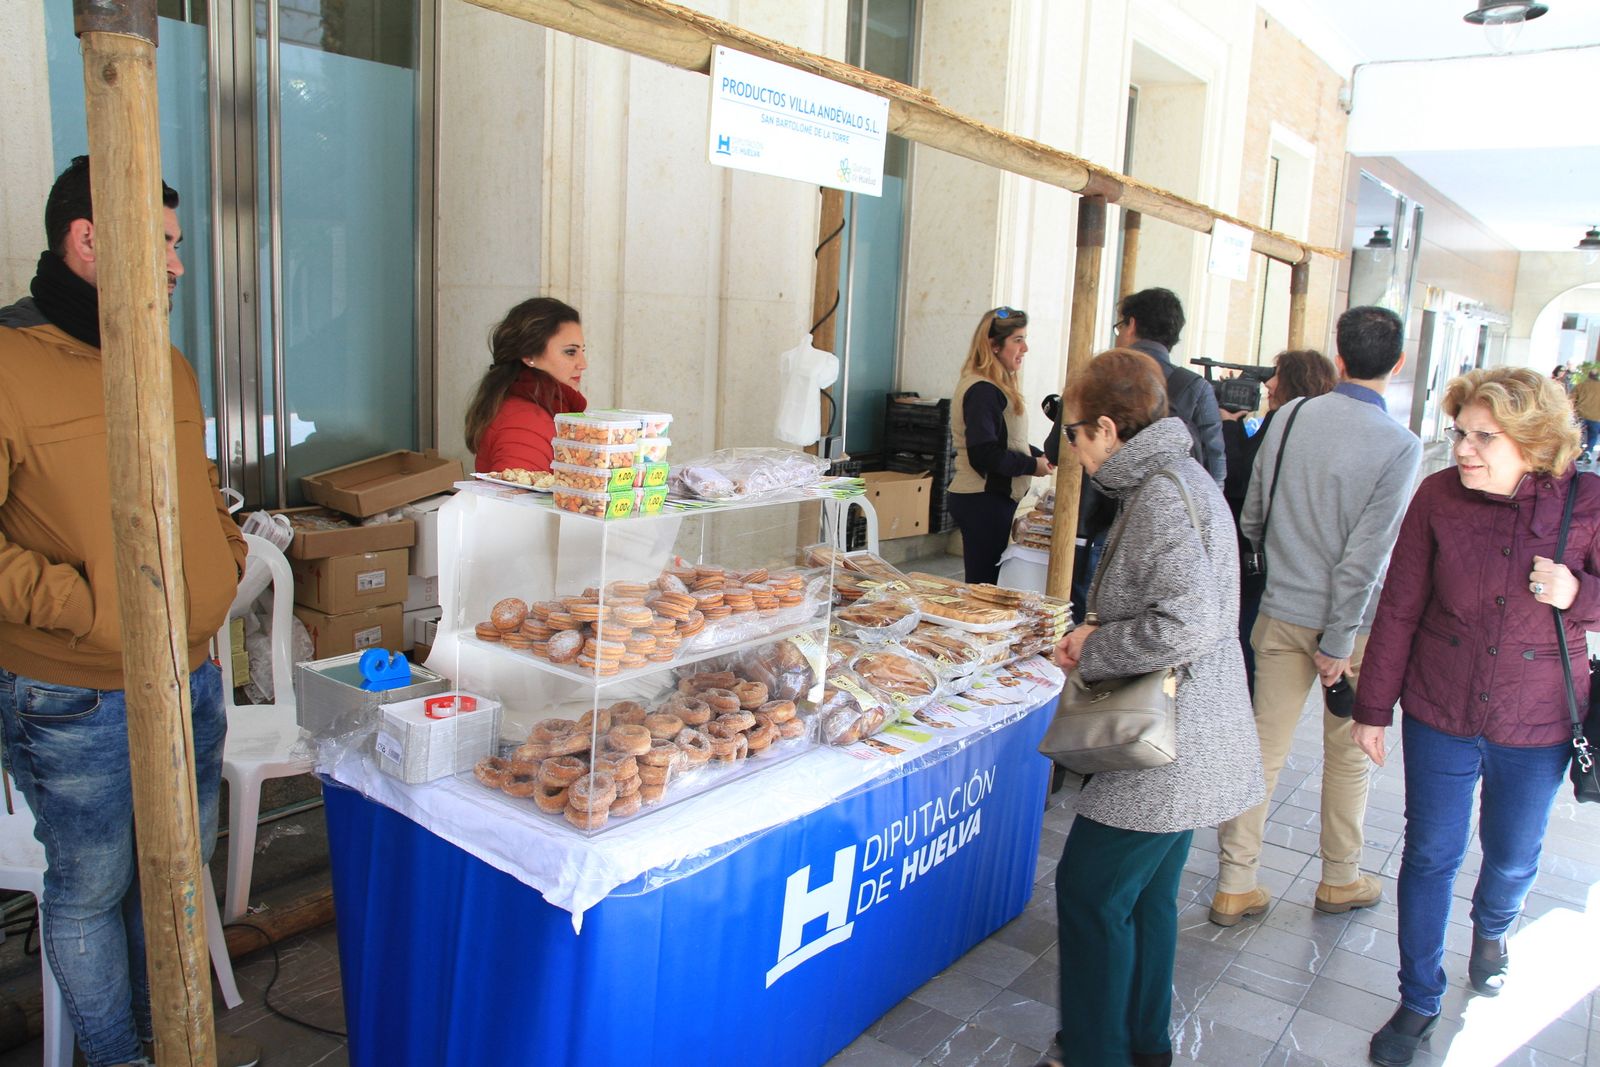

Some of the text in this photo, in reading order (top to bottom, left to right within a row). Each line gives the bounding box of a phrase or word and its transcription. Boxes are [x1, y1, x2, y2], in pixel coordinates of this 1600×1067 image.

[722, 77, 880, 135] PRODUCTOS VILLA ANDÉVALO S.L.
[761, 113, 774, 124] SAN
[814, 127, 822, 137] DE
[823, 129, 831, 139] LA
[832, 131, 850, 144] TORRE
[862, 765, 996, 872] DIPUTACIÓN
[856, 808, 981, 916] DE HUELVA
